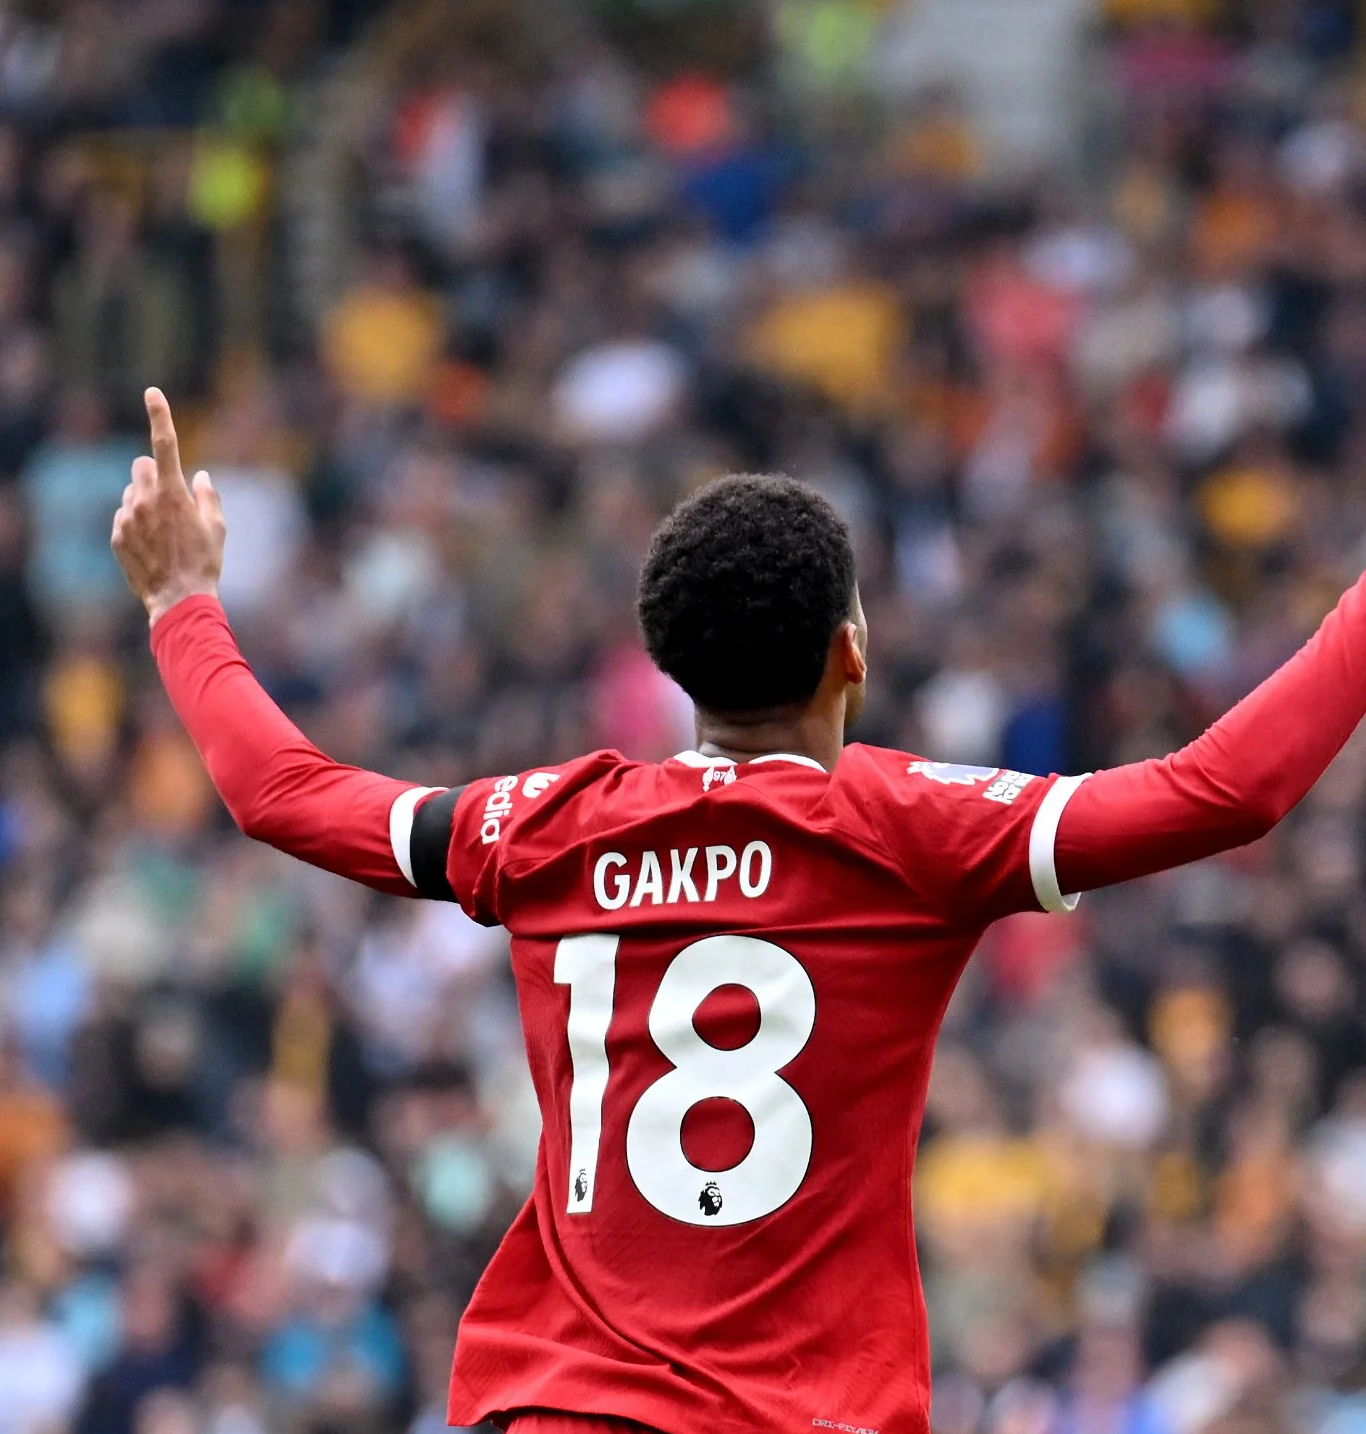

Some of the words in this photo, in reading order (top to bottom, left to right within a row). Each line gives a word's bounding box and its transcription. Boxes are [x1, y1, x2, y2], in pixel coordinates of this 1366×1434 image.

[714, 771, 727, 782] 97
[593, 839, 773, 912] GAKPO
[553, 933, 817, 1228] 18
